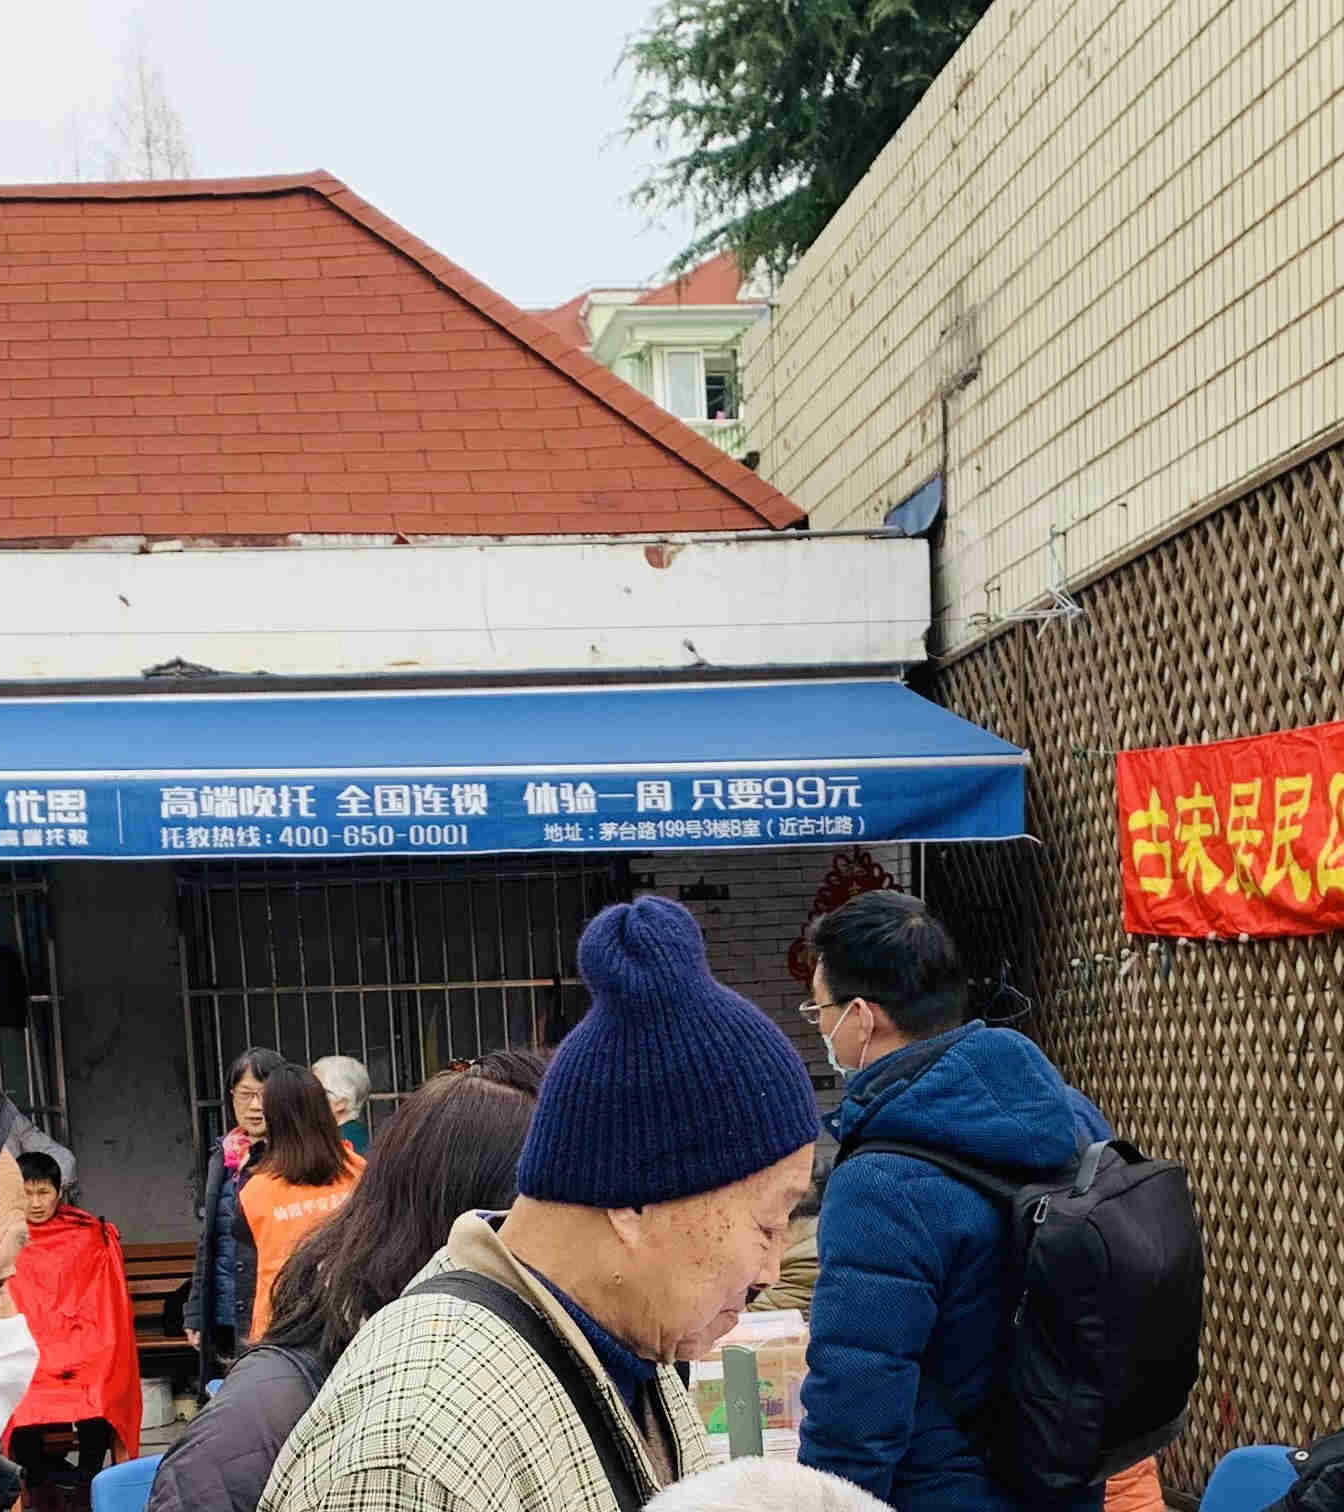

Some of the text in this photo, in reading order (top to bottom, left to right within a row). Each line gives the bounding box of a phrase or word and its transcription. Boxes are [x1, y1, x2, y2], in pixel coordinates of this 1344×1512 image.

[159, 776, 862, 819] 高端晚托 全国连锁 体验一周 只要99元
